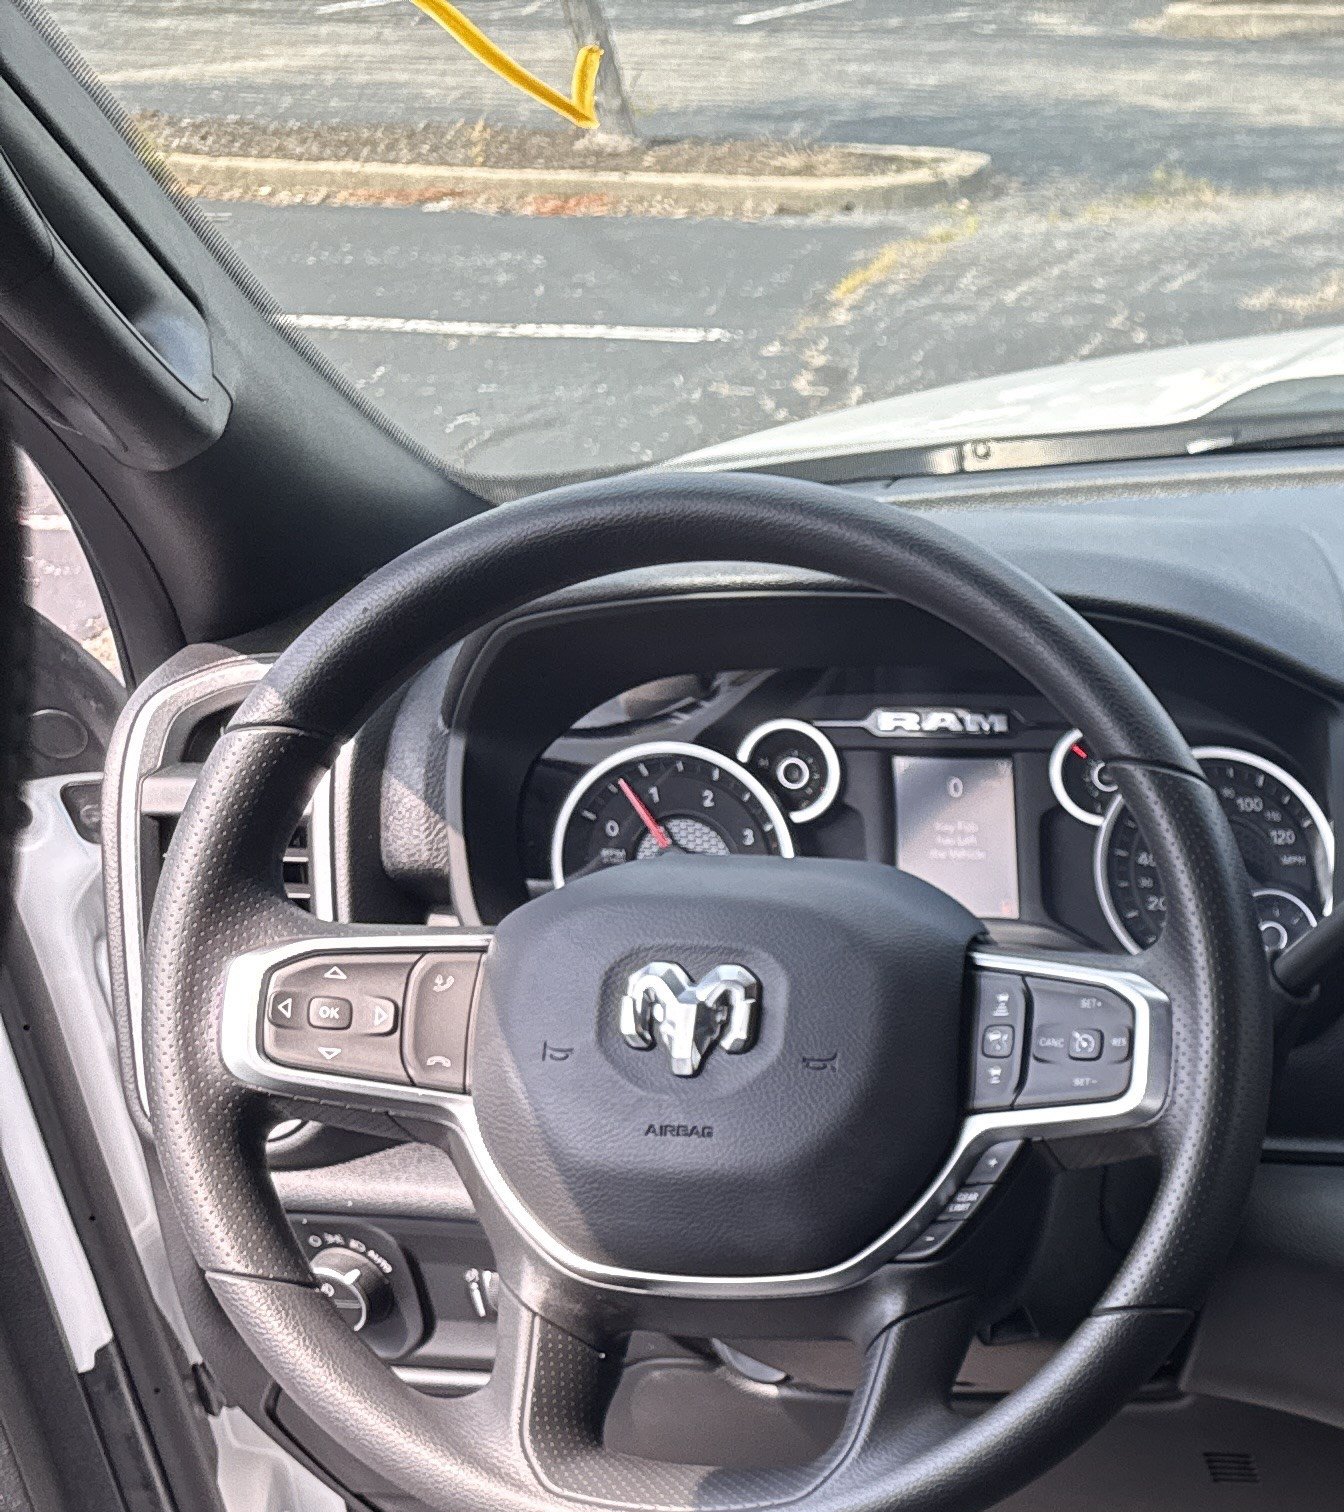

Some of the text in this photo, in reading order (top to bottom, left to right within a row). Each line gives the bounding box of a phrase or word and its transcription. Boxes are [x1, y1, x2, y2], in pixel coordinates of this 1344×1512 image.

[877, 710, 1009, 733] RAM
[649, 786, 660, 804] 1
[949, 778, 964, 798] 0
[702, 789, 715, 808] 2
[1236, 796, 1264, 813] 100
[605, 819, 620, 837] 0
[742, 828, 755, 846] 3
[1269, 828, 1296, 846] 120
[319, 1005, 340, 1020] OK
[1039, 1037, 1065, 1048] CANC
[644, 1123, 715, 1139] AIRBAG
